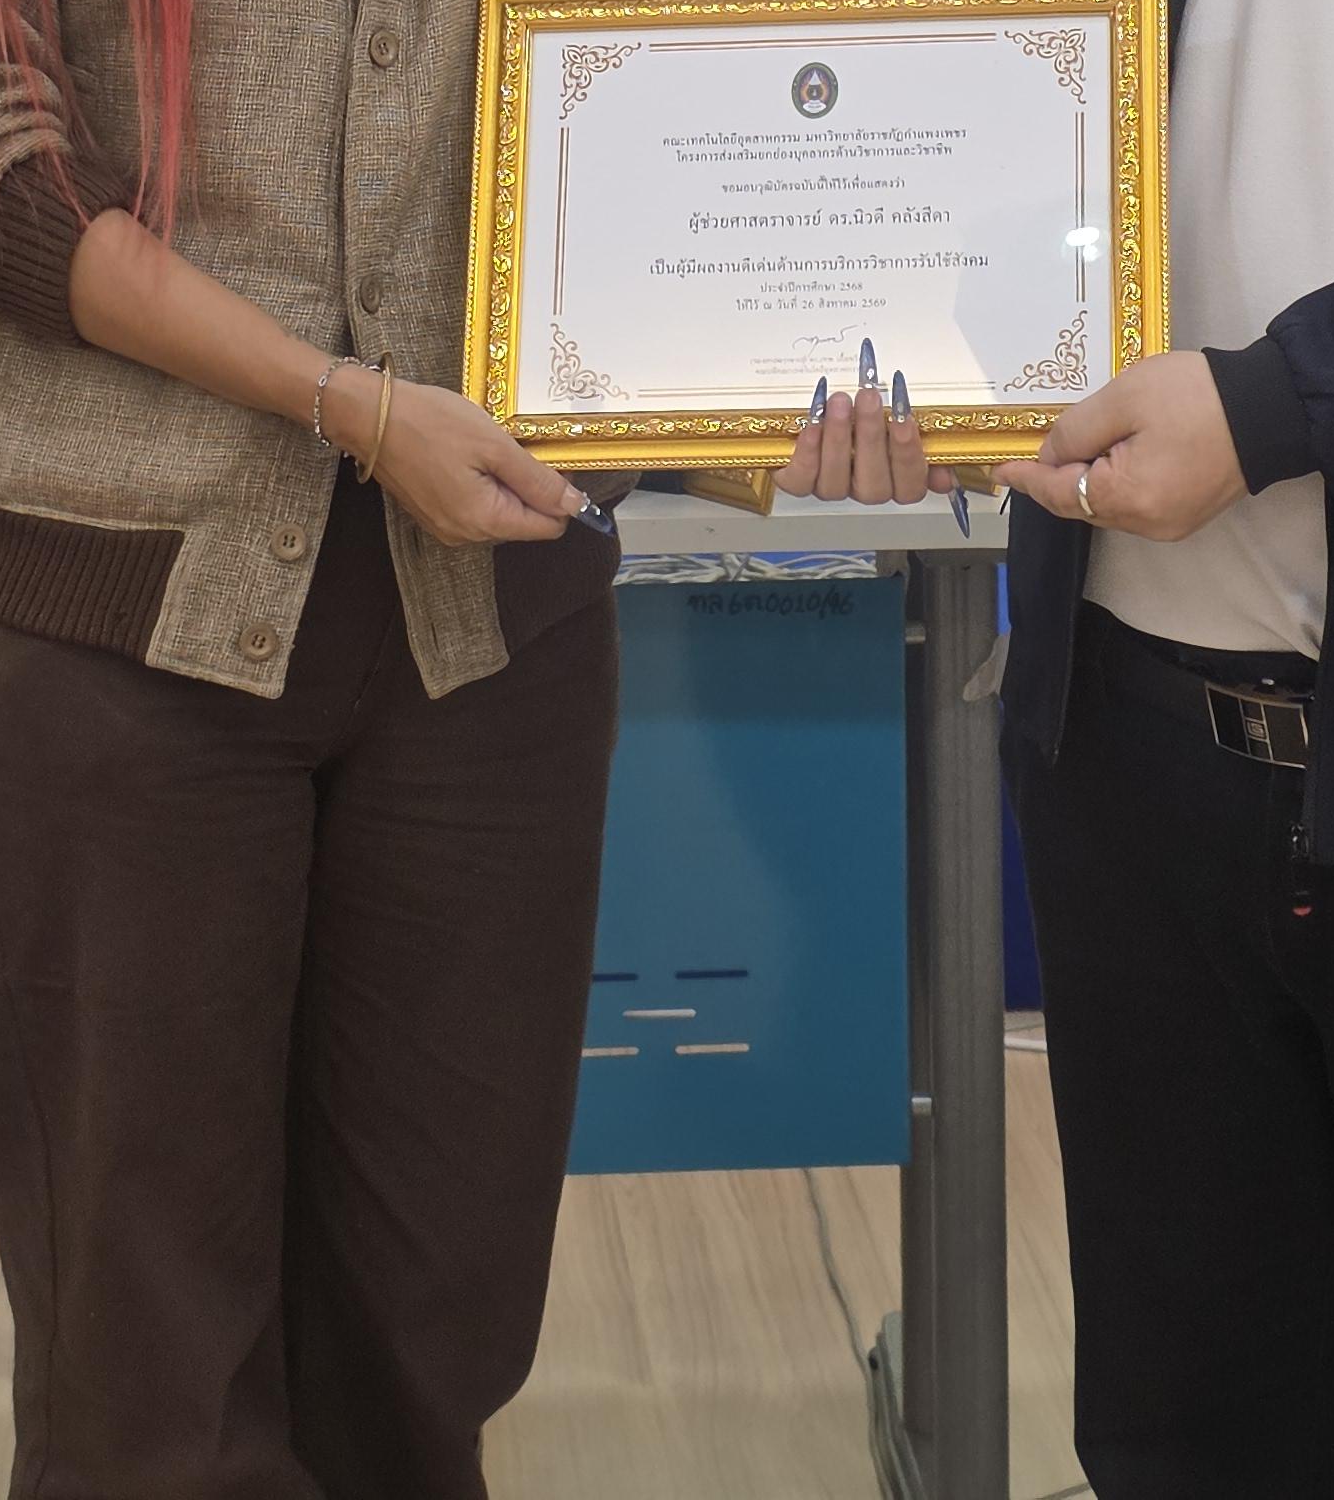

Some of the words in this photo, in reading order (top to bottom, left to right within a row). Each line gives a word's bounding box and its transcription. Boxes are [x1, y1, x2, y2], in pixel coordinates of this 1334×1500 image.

[662, 132, 801, 148] คณะเทคโนโลยีอุตสาหกรรม
[805, 127, 967, 143] มหาวิทยาลัยราชภัฏกำแพงเพชร
[689, 208, 822, 234] ผู้ช่วยศาสตราจารย์
[829, 206, 884, 226] ดร.นิวดี
[891, 205, 951, 224] คลังสีดา
[649, 251, 989, 279] เป็นผู้มีผลงานดีเด่นด้านการบริการวิชาการรับใช้สังคม
[778, 294, 797, 310] วันที่
